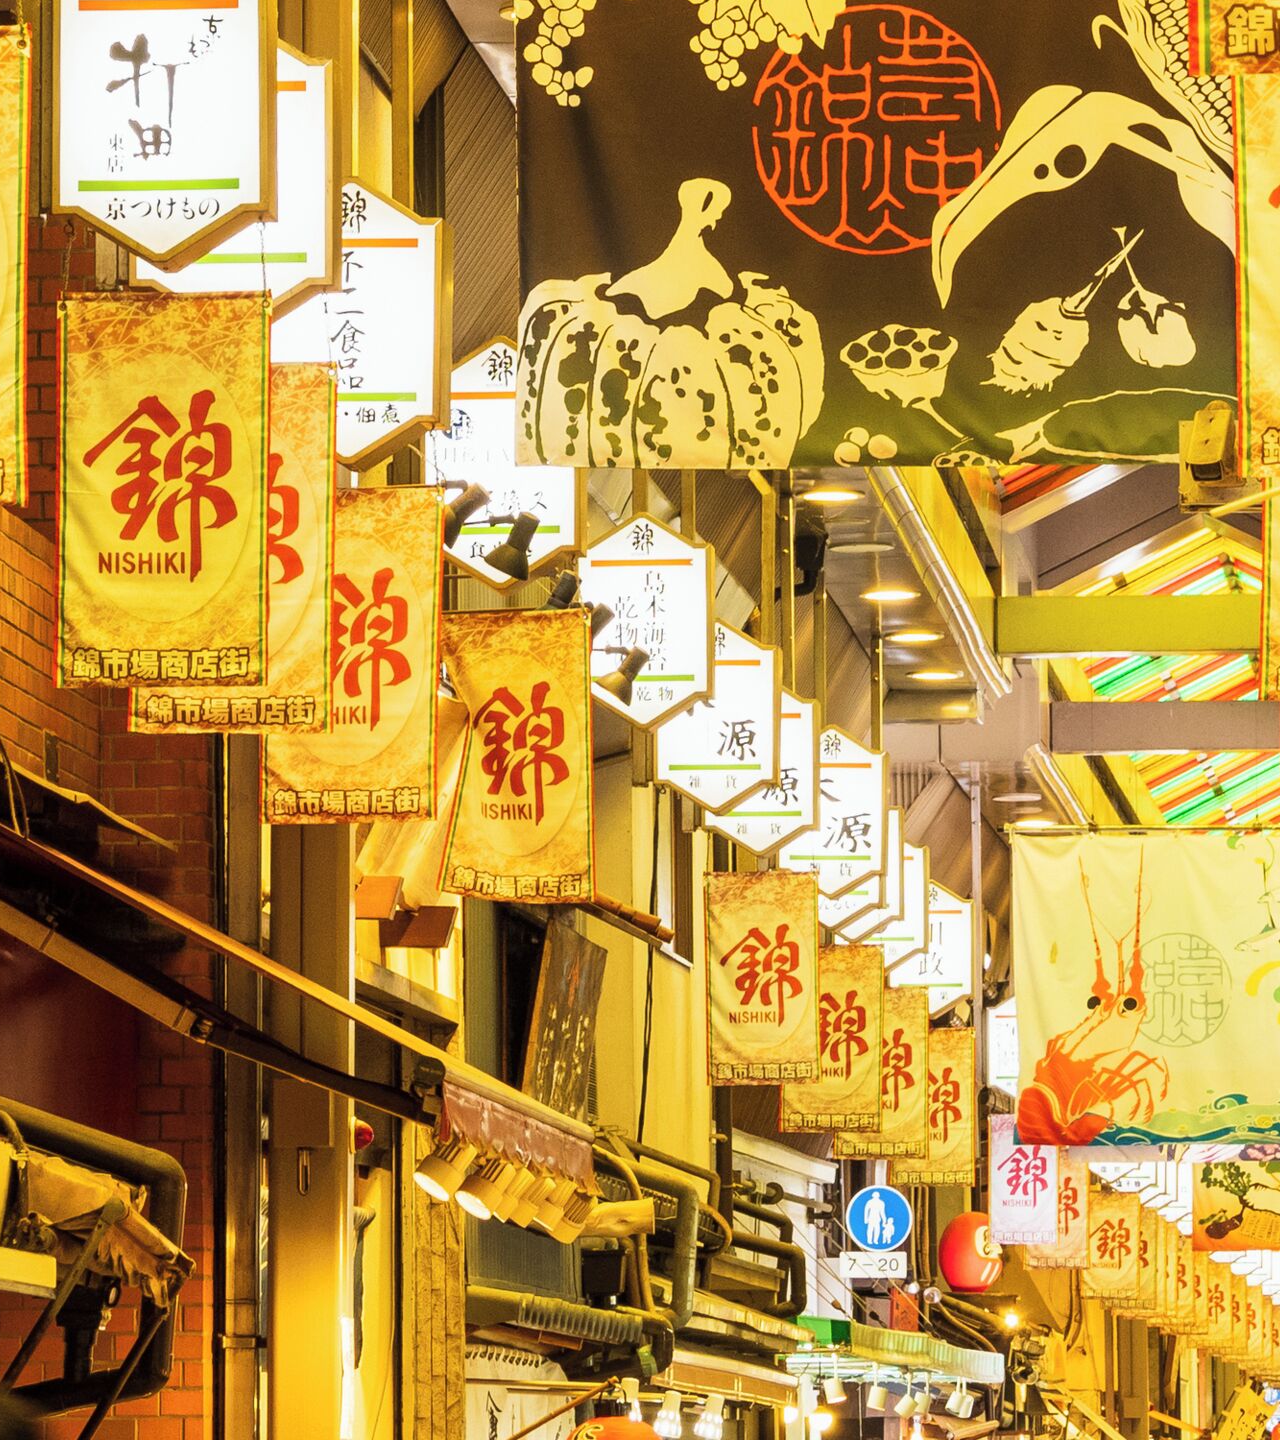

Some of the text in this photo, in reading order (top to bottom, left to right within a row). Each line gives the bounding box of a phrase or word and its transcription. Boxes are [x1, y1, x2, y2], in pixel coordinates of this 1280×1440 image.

[105, 33, 190, 161] 打田
[104, 196, 220, 220] 京つけもの
[341, 190, 367, 233] 錦
[480, 349, 514, 388] 錦
[83, 390, 239, 584] 錦
[626, 523, 654, 554] 錦
[98, 552, 187, 575] NISHIKI
[72, 647, 249, 680] 錦市場商店街
[145, 696, 316, 727] 錦市場商店街
[331, 704, 368, 726] HIKI
[473, 681, 569, 826] 錦
[272, 789, 420, 816] 錦市場商店街
[452, 865, 583, 898] 錦市場商店街
[720, 923, 803, 1027] 錦
[729, 1011, 777, 1024] NISHIKI
[820, 990, 869, 1080] 錦
[716, 1062, 813, 1080] 錦市場商店街
[821, 1065, 844, 1078] HIKI
[788, 1112, 875, 1129] 錦市場商店街
[997, 1145, 1048, 1208] 錦
[1002, 1199, 1033, 1207] NISHIKI
[1089, 1218, 1131, 1269] 錦
